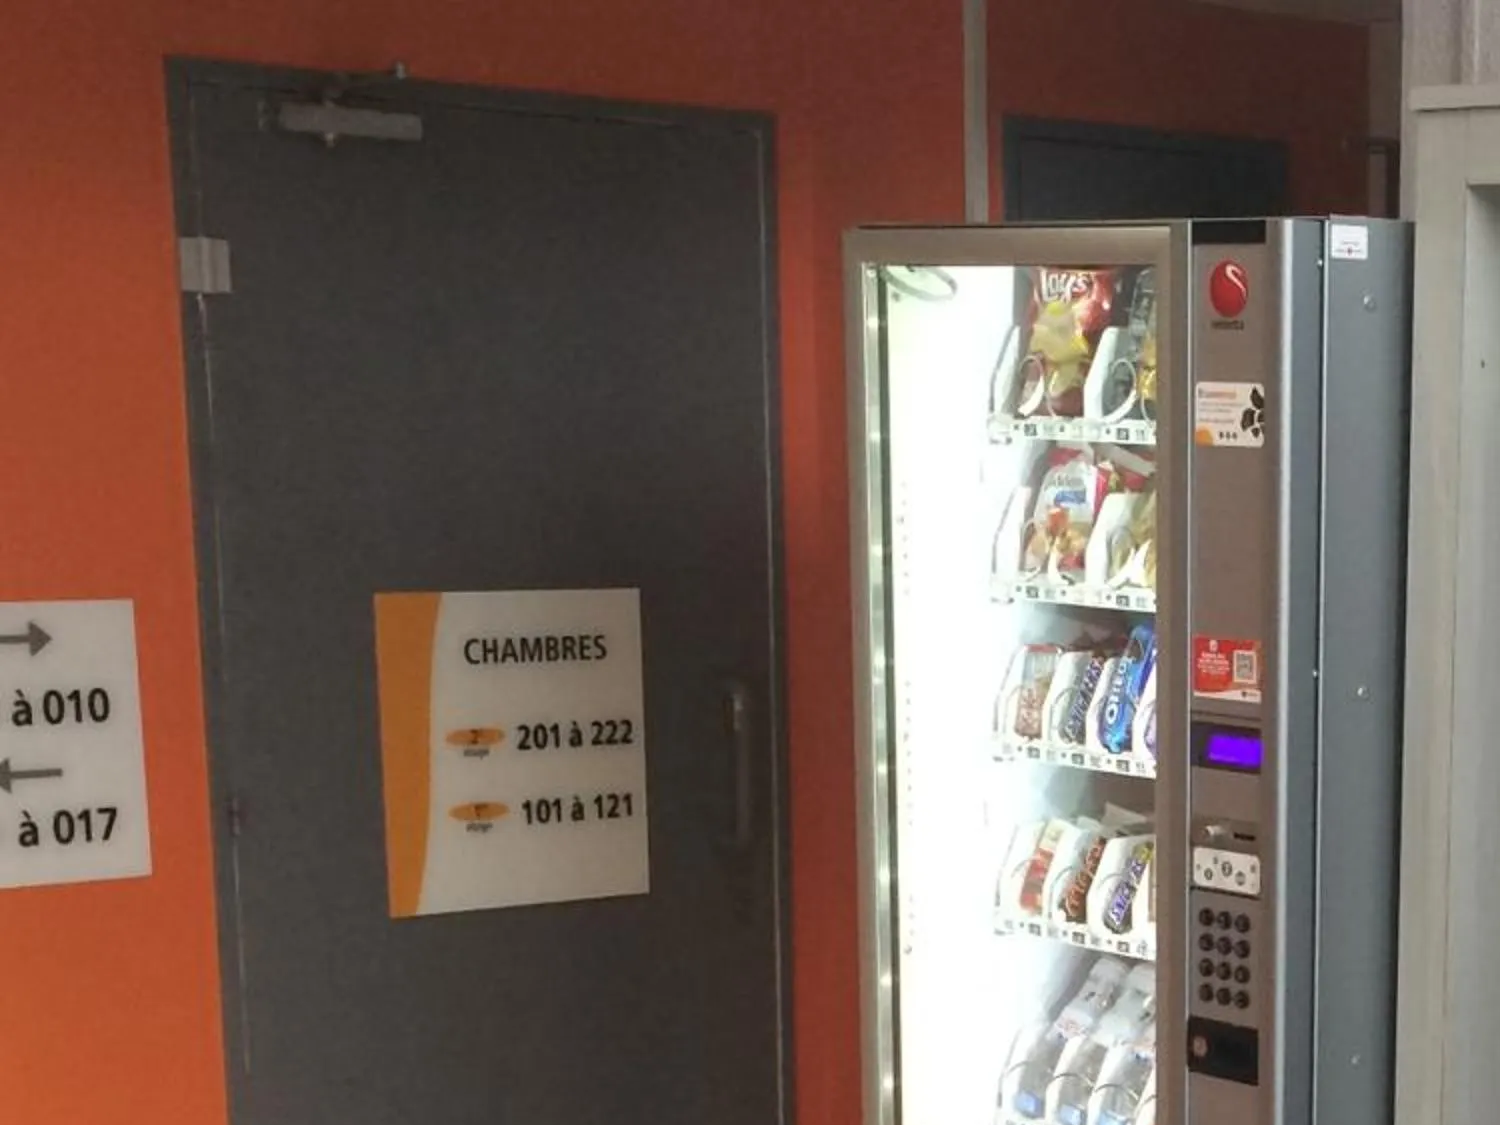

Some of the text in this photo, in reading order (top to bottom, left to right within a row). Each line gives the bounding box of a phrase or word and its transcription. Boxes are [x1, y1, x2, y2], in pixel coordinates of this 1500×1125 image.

[464, 635, 608, 665] CHAMBRES
[11, 687, 110, 726] à 010
[517, 723, 560, 751] 201
[569, 720, 583, 748] à
[591, 718, 634, 746] 222
[522, 797, 562, 826] 101
[571, 795, 585, 822] à
[594, 792, 633, 820] 121
[18, 807, 118, 847] à 017
